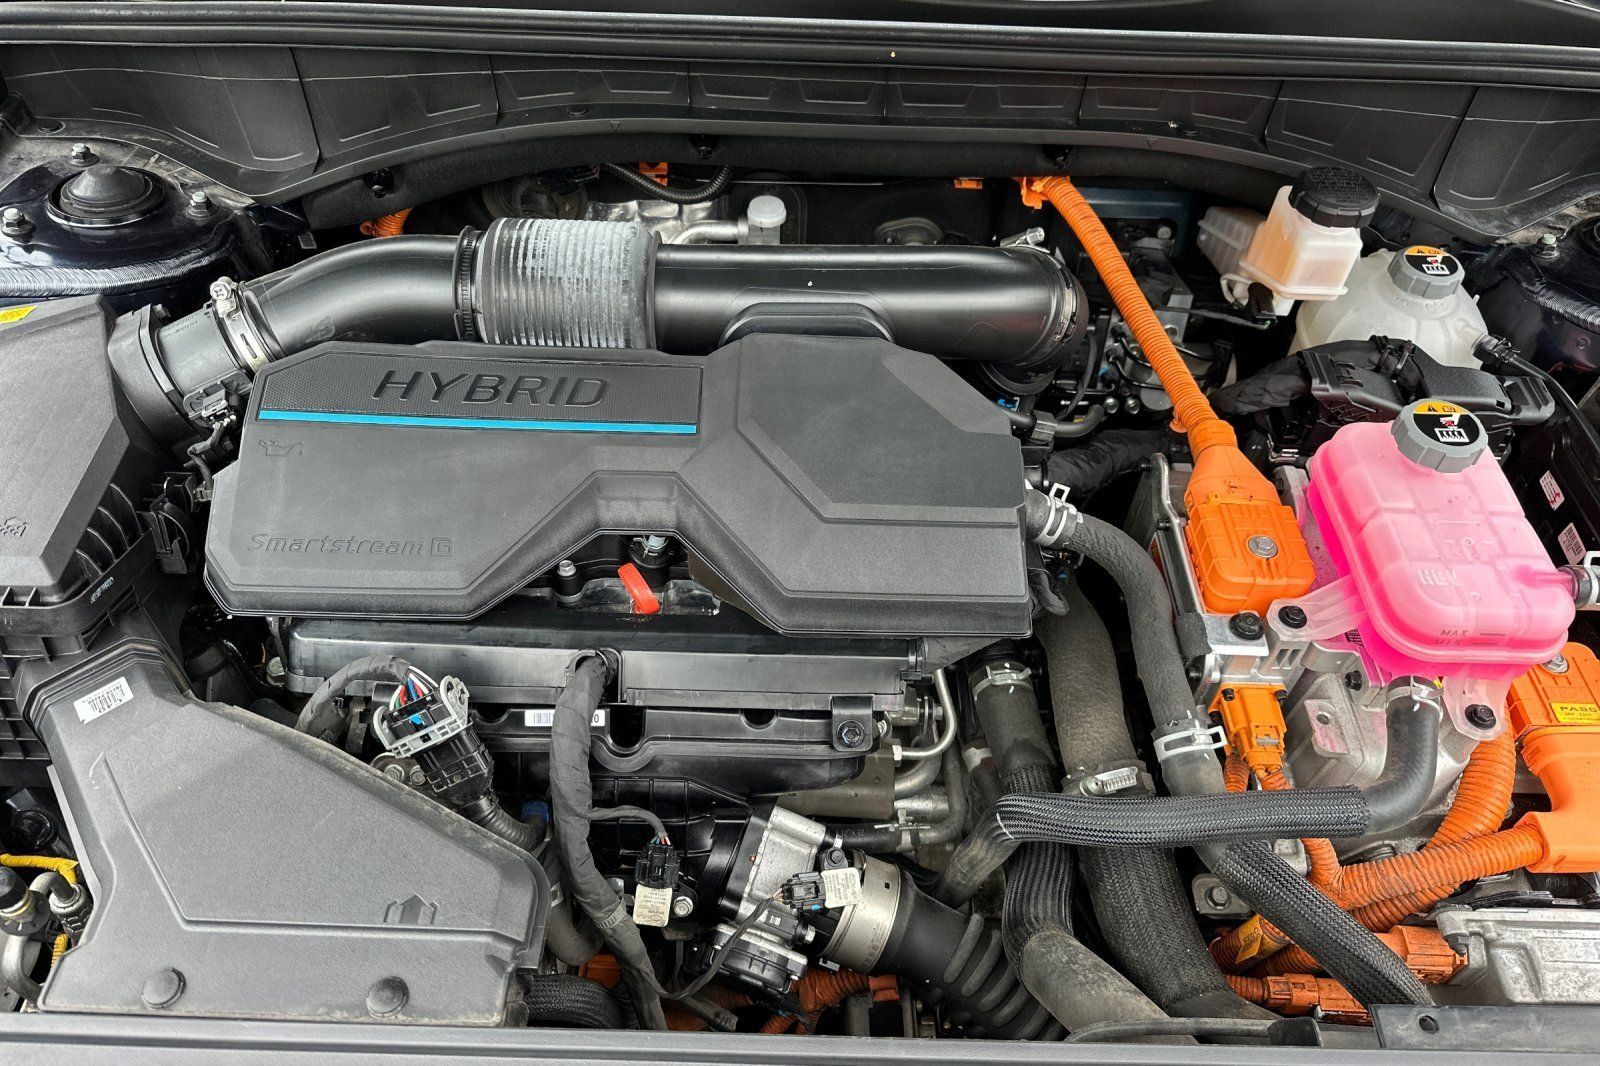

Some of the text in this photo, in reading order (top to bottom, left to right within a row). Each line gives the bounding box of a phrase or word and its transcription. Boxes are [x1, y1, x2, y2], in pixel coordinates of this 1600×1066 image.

[372, 369, 608, 408] HYBRID
[251, 533, 421, 555] Smartstream
[1440, 629, 1469, 637] MAX
